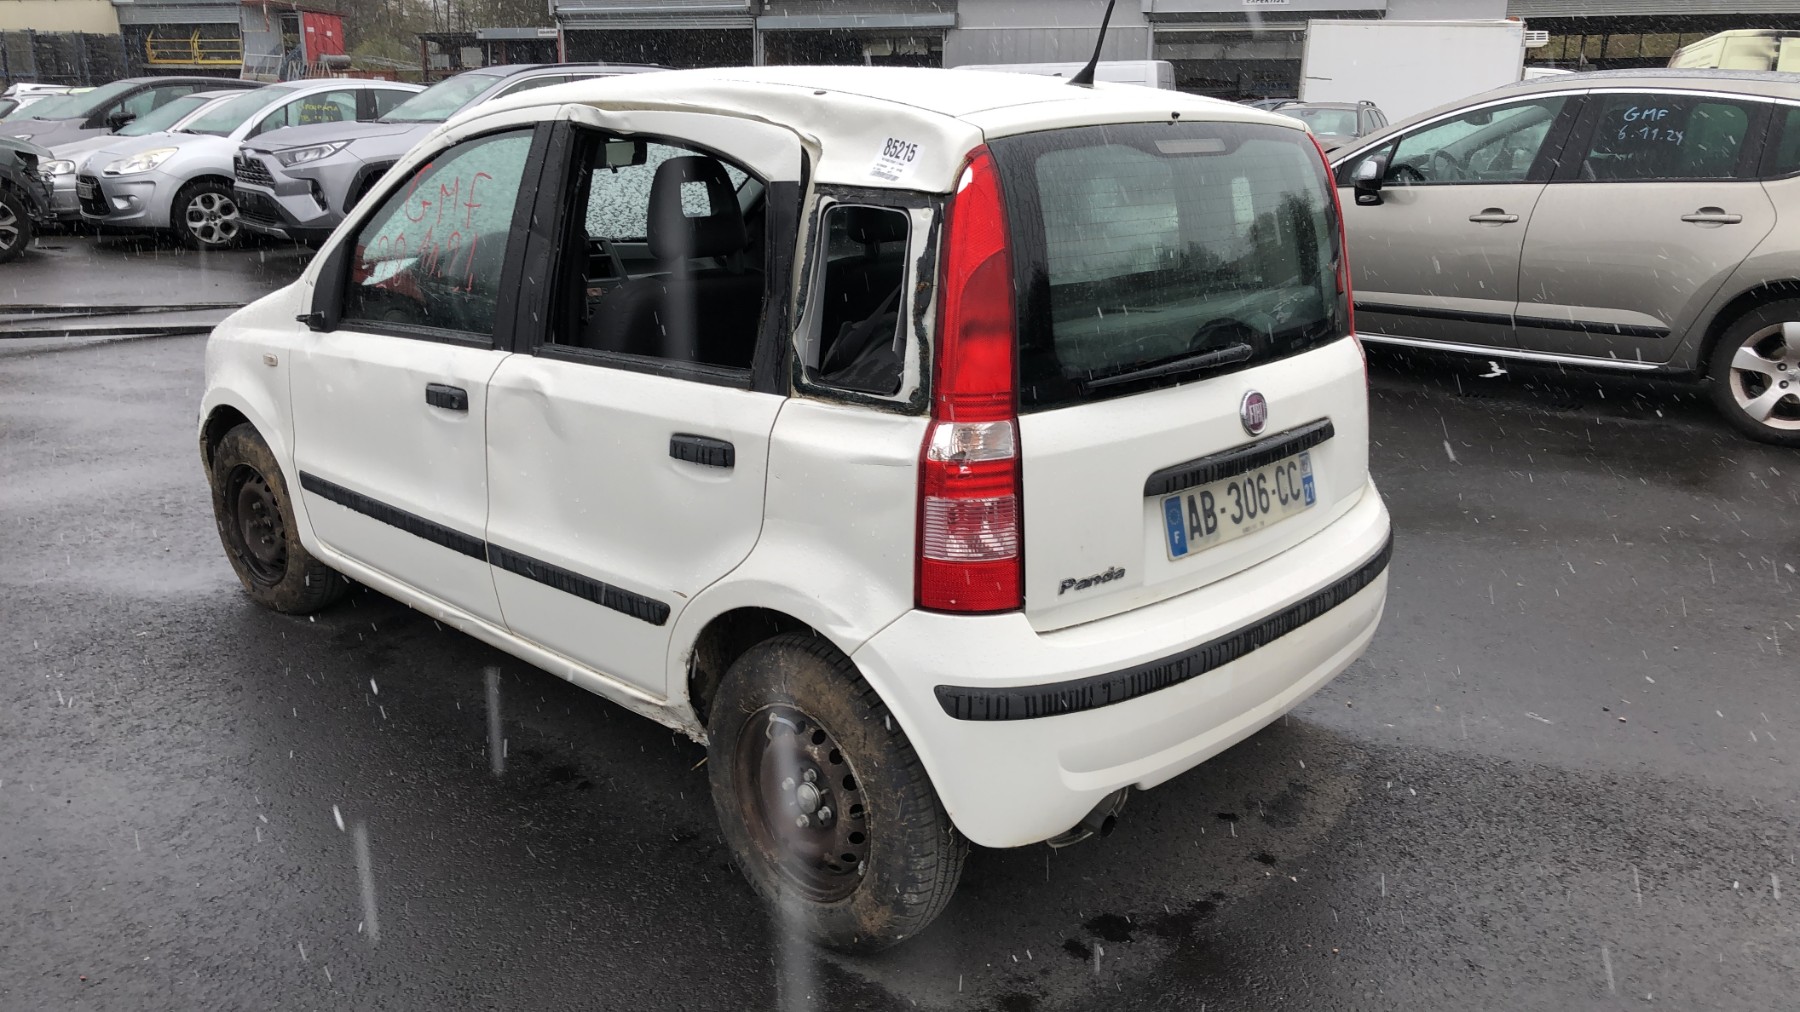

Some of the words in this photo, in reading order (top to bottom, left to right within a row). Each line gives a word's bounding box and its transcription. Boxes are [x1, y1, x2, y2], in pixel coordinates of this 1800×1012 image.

[1623, 106, 1669, 121] GMF
[882, 137, 919, 163] 85215
[405, 163, 493, 229] GMF
[1186, 460, 1301, 541] AB-306-CC
[1173, 530, 1181, 545] F
[1058, 566, 1126, 596] Panda
